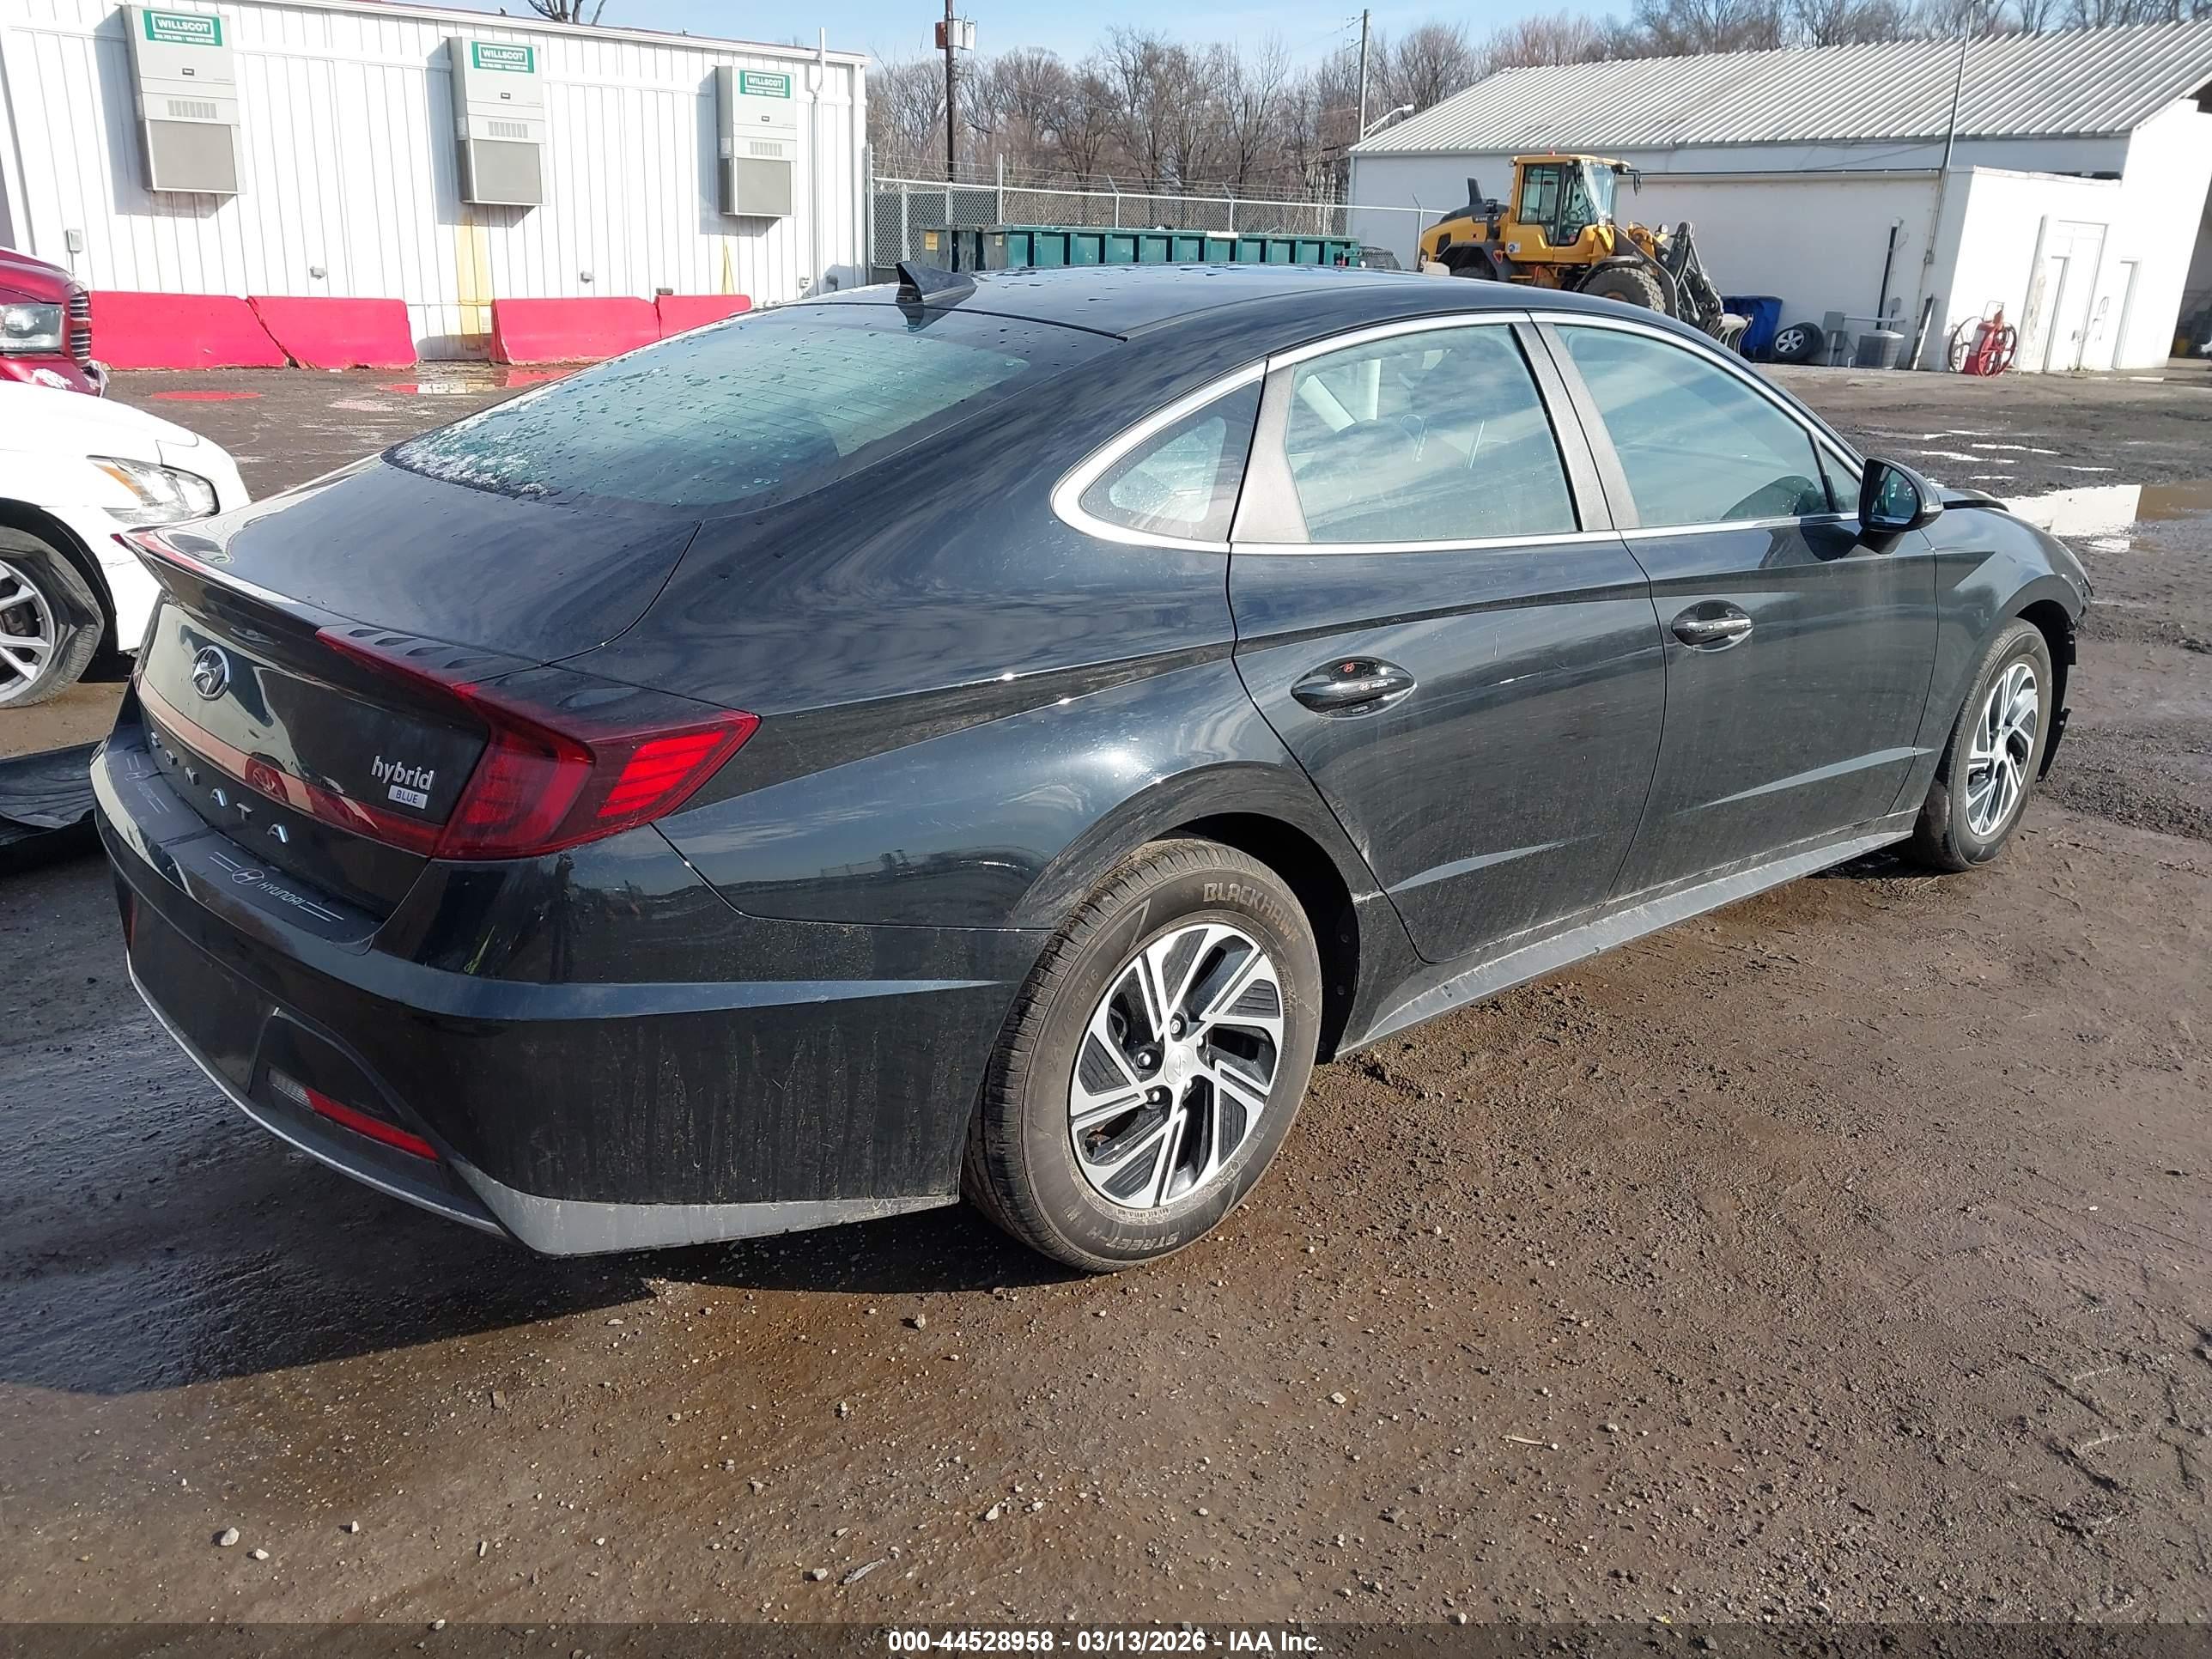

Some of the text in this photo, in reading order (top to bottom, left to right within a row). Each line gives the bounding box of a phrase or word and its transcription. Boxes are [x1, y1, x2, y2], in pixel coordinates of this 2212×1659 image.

[157, 19, 209, 32] WILLSCOT
[482, 49, 524, 60] WILLSCOT
[748, 76, 782, 88] WILLSCOT
[371, 756, 434, 790] hybrid
[150, 731, 289, 844] SONATA
[396, 789, 419, 805] BLUE
[257, 881, 306, 907] HYUNDAI
